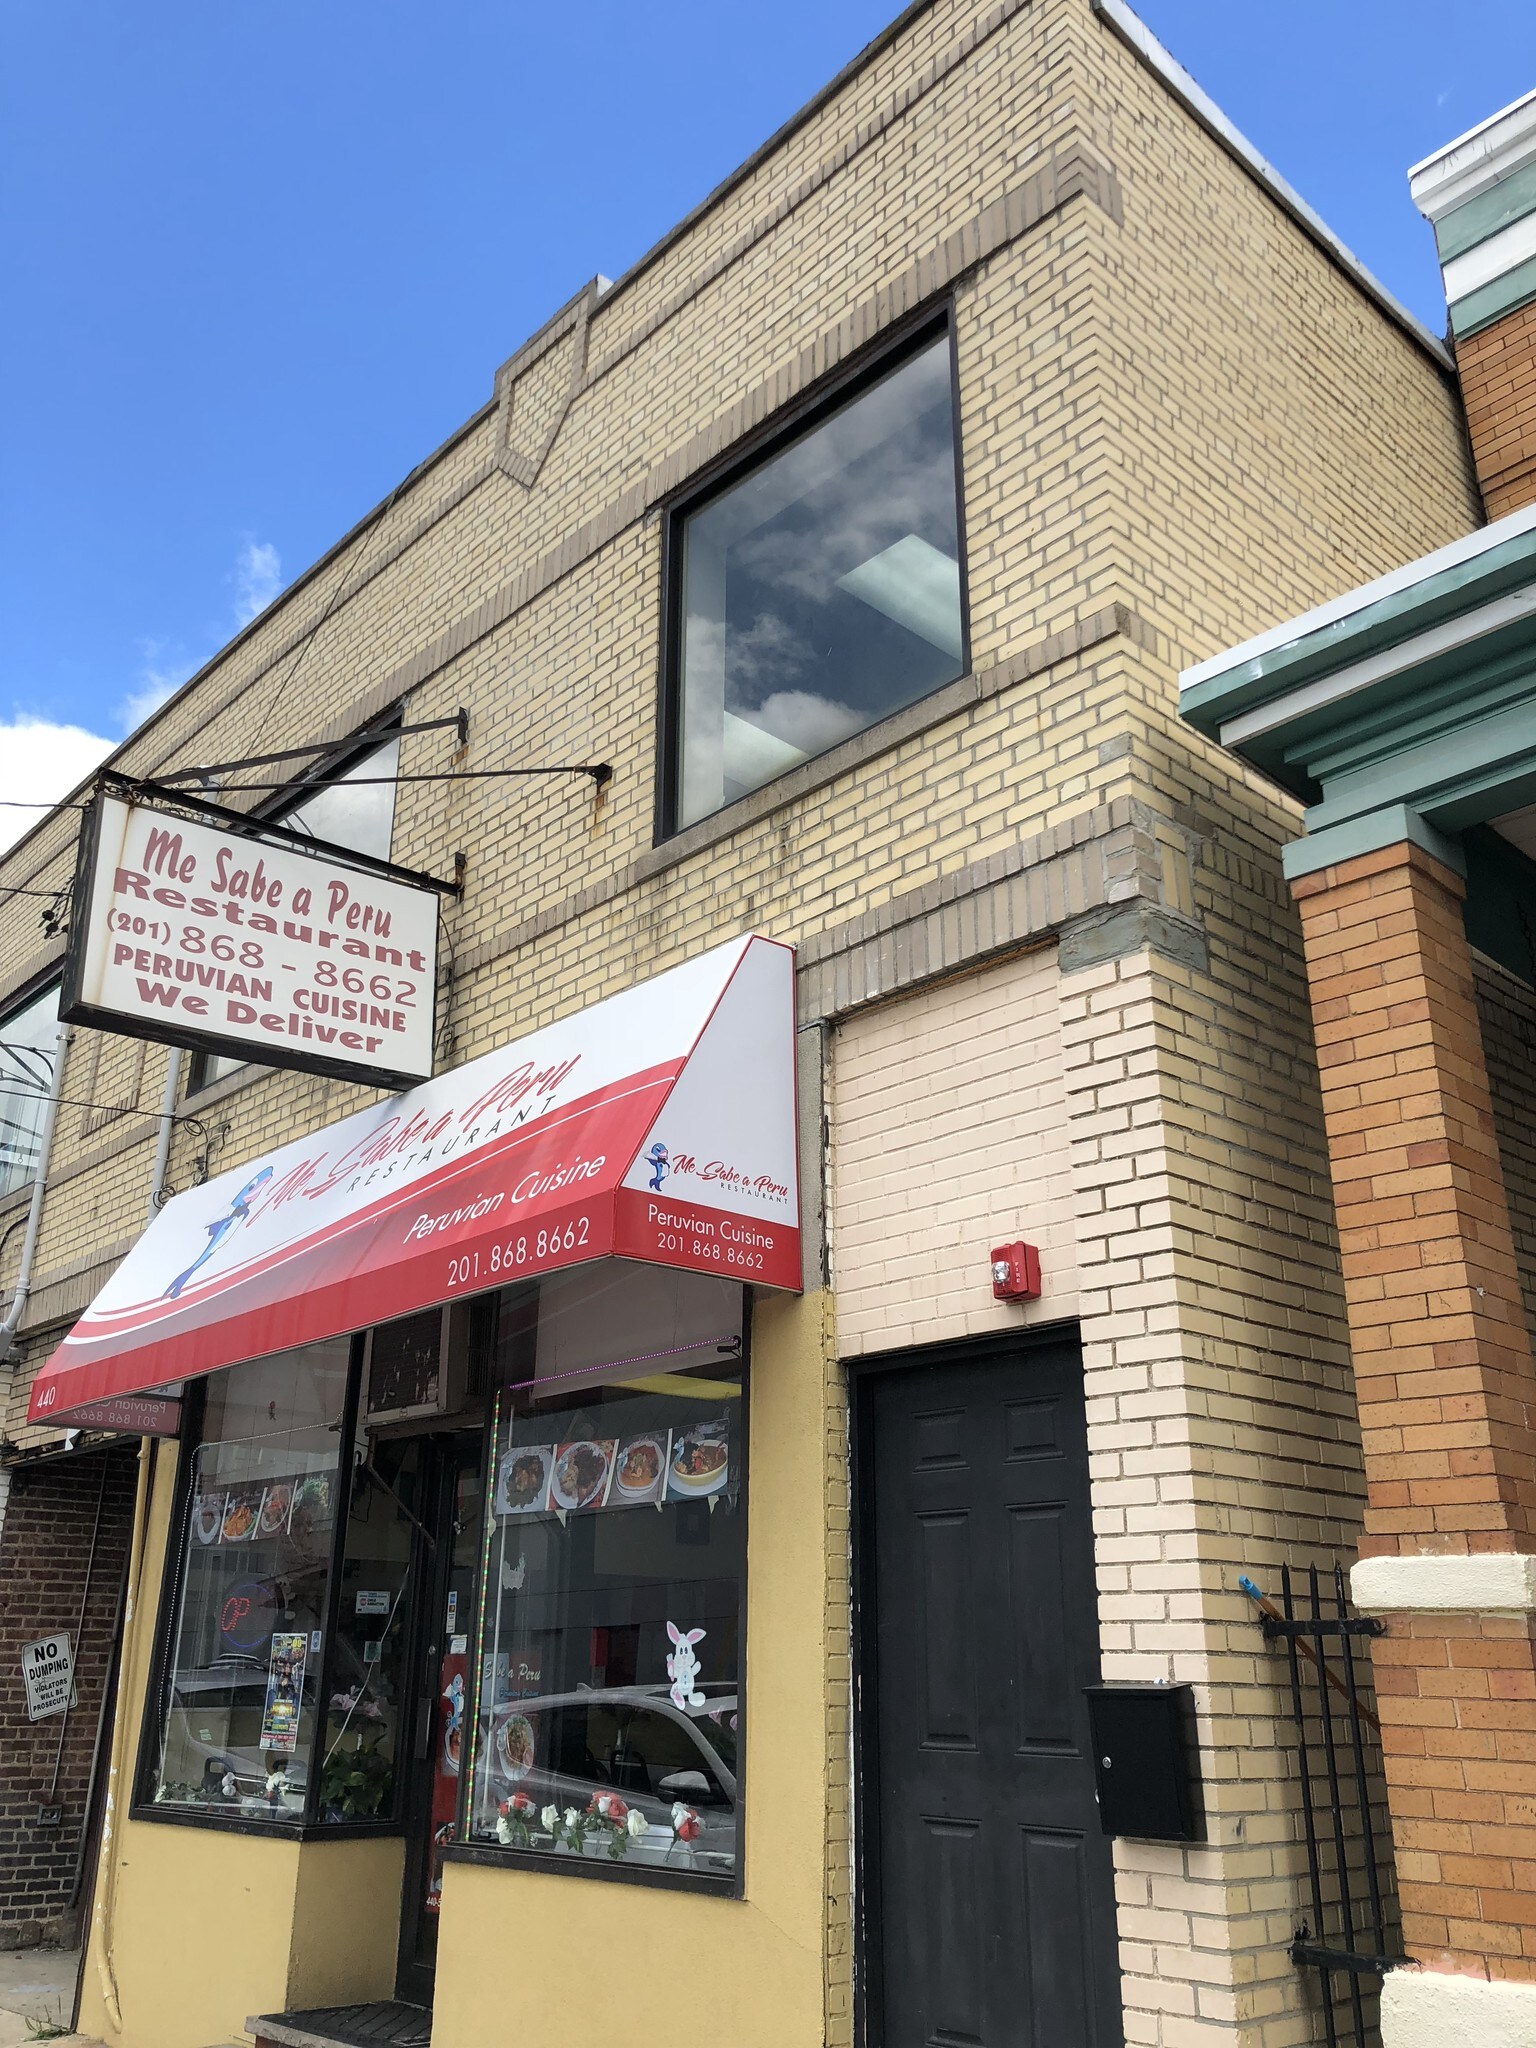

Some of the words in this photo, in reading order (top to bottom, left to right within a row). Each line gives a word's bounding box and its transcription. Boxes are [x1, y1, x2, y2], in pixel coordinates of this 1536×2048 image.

[143, 827, 197, 883] Me
[211, 847, 281, 907] Sabe
[292, 883, 312, 916] a
[327, 880, 392, 939] Peru
[113, 867, 427, 973] Restaurant
[106, 907, 172, 946] (201)
[179, 925, 265, 970] 868
[313, 960, 418, 1008] 8662
[114, 943, 273, 1001] PERUVIAN
[292, 988, 407, 1033] CUISINE
[135, 977, 209, 1015] We
[226, 1000, 384, 1053] Deliver
[246, 1152, 329, 1228] Me
[301, 1107, 429, 1200] Sabe
[422, 1108, 454, 1144] a
[458, 1053, 581, 1133] Peru
[346, 1095, 556, 1193] RESTAURANT
[672, 1154, 696, 1174] Me
[696, 1161, 740, 1184] Sabe
[742, 1175, 750, 1186] a
[753, 1175, 788, 1198] Peru
[720, 1182, 788, 1205] RESTAURANT
[403, 1192, 505, 1244] Peruvian
[511, 1155, 606, 1204] Cuisine
[648, 1203, 715, 1237] Peruvian
[719, 1221, 774, 1249] Cuisine
[448, 1216, 590, 1286] 201.868.8662
[657, 1233, 764, 1269] 201.868.8662
[37, 1386, 56, 1409] 440
[29, 1658, 69, 1680] DUMPING
[34, 1643, 58, 1663] NO
[518, 1663, 542, 1680] Peru
[34, 1678, 68, 1693] VIOLATORS
[40, 1691, 54, 1700] WILL
[55, 1687, 64, 1696] BE
